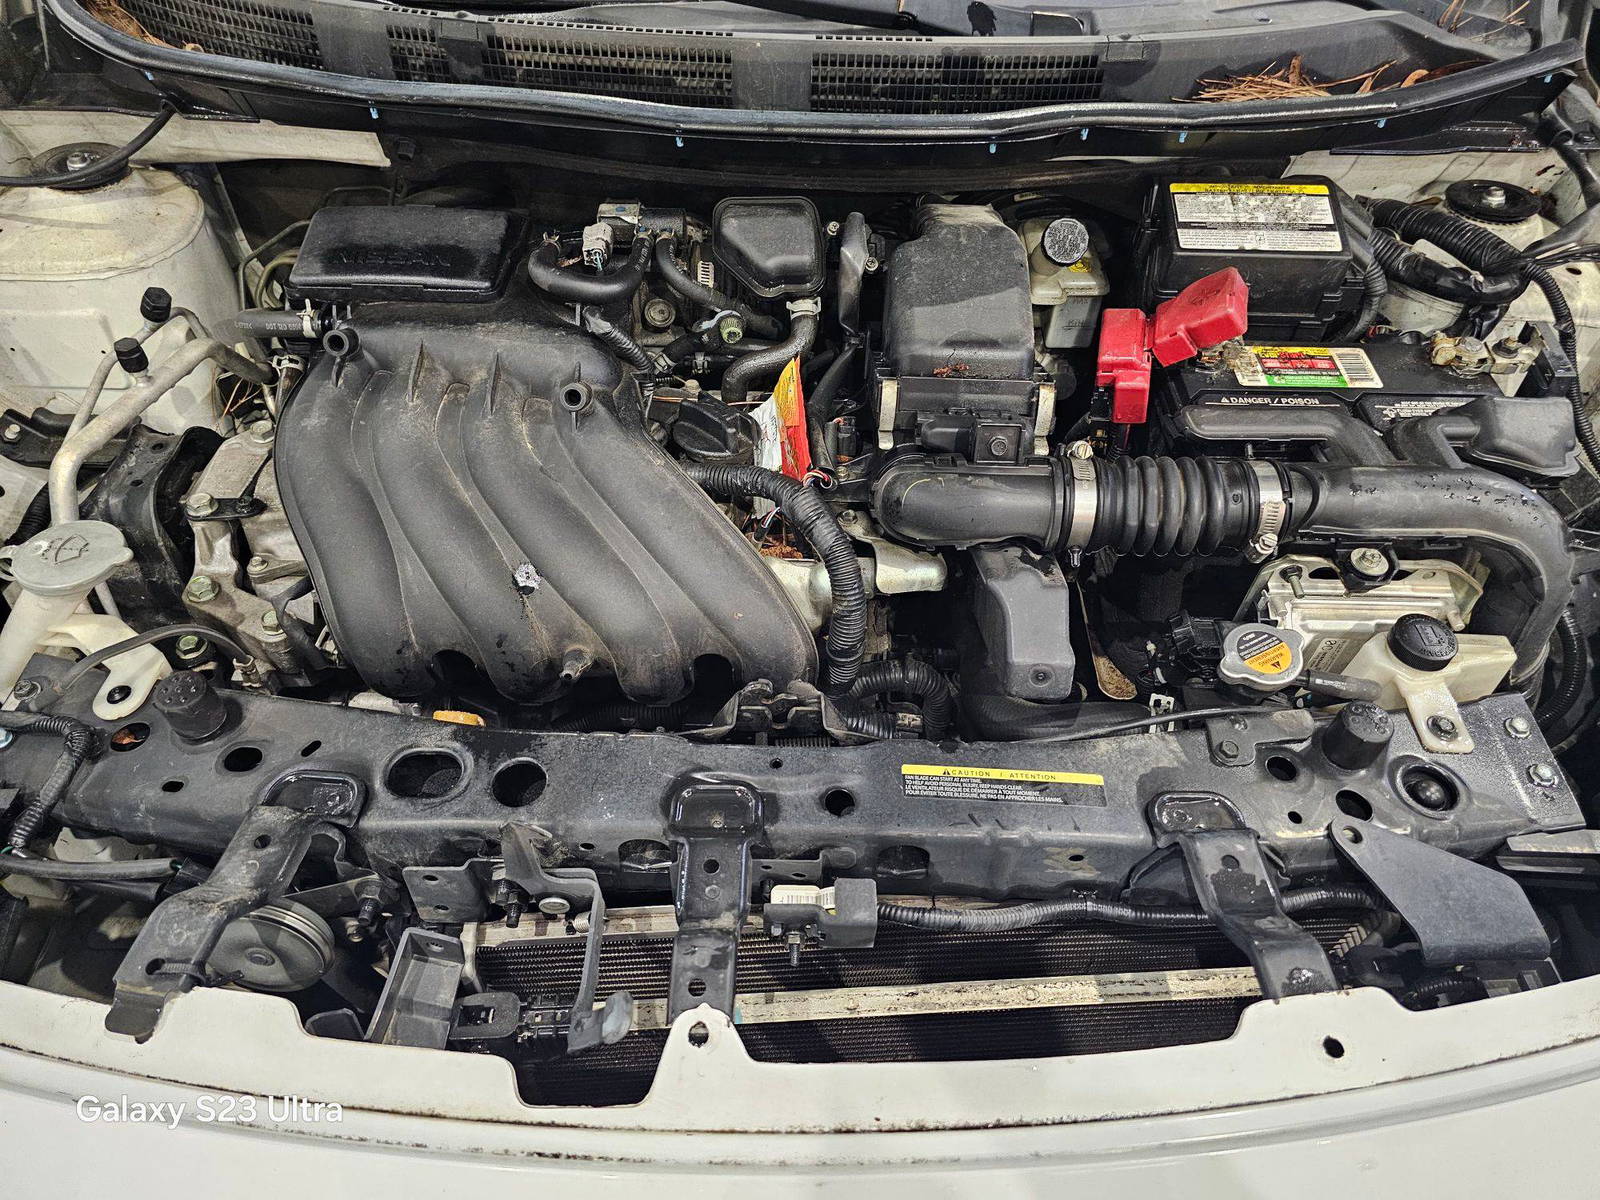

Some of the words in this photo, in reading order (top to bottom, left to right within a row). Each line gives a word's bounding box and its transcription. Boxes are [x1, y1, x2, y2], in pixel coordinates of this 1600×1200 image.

[1280, 397, 1320, 405] POISON
[951, 769, 991, 777] CAUTION
[1009, 772, 1056, 780] ATTENTION
